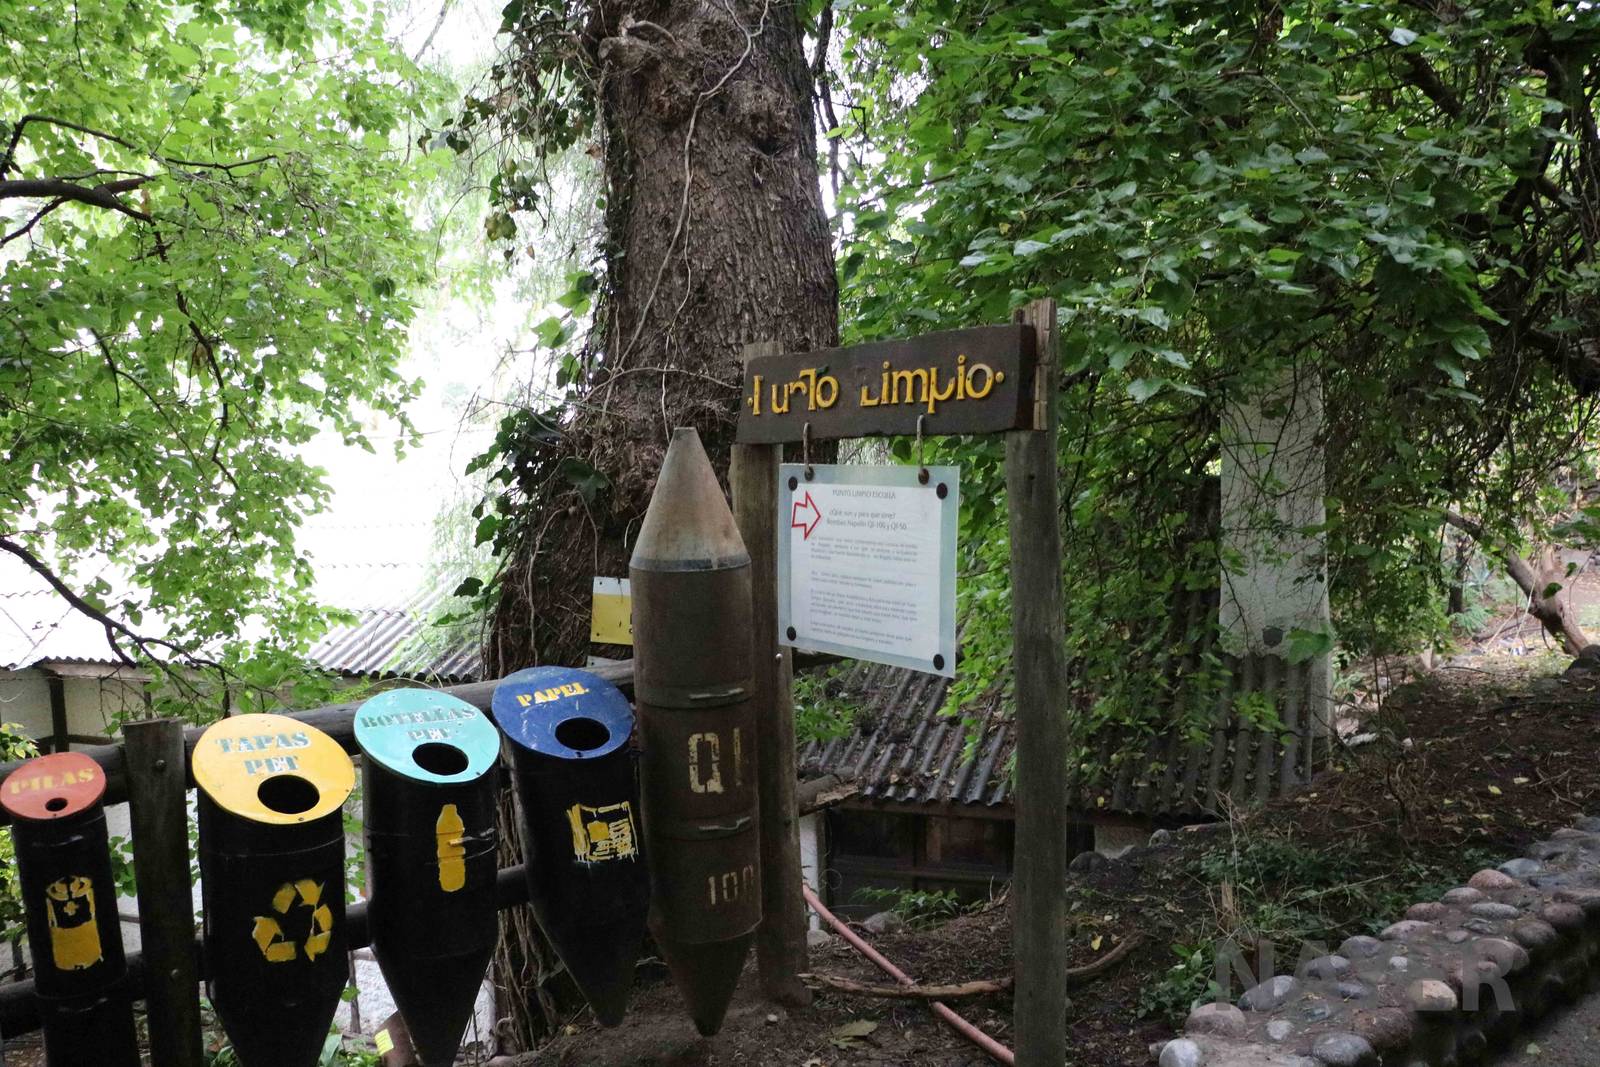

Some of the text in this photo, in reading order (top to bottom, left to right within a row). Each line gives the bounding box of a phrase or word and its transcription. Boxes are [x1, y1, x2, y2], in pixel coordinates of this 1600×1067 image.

[516, 681, 591, 708] PAPEL
[361, 706, 477, 728] BOTELLAS
[215, 731, 311, 753] TAPAS
[243, 755, 299, 775] PET
[9, 768, 94, 795] PILAS
